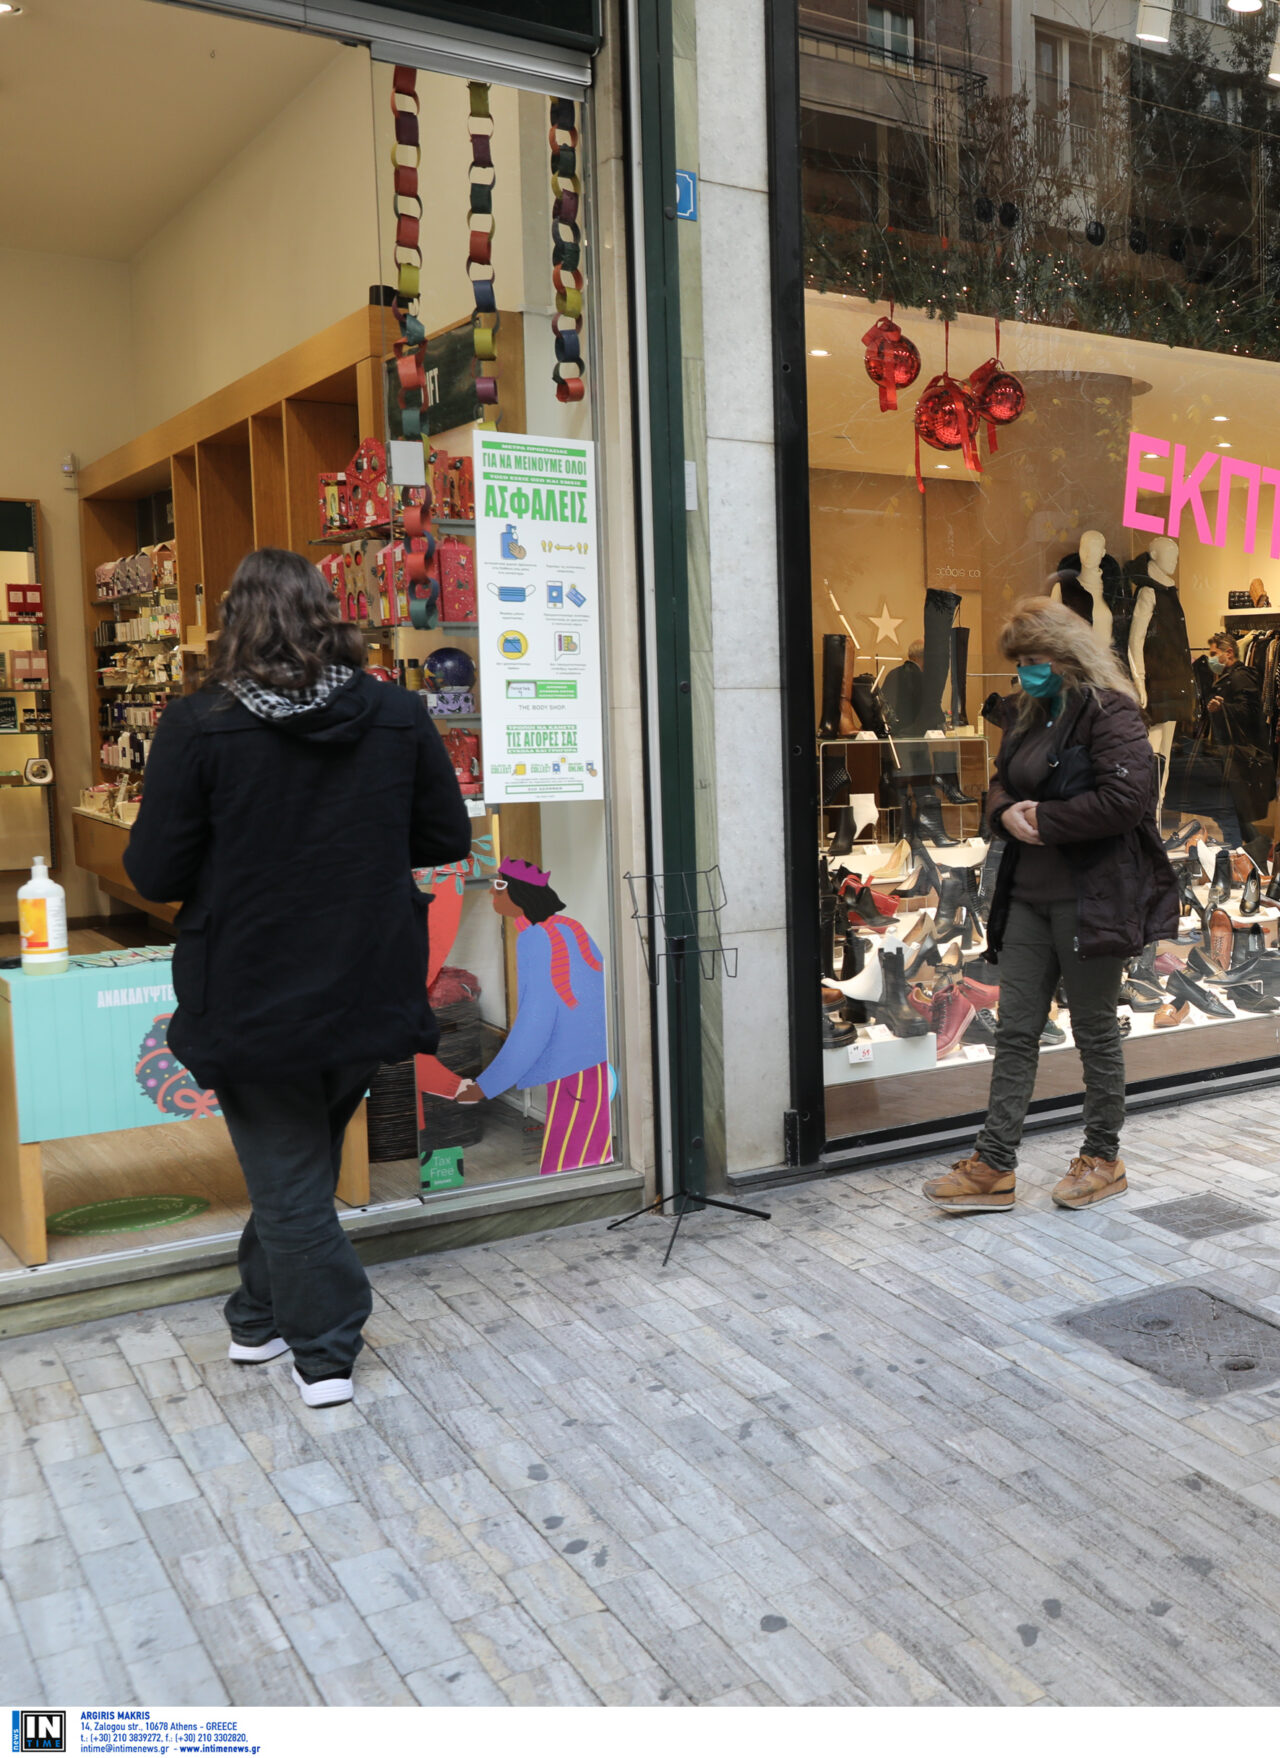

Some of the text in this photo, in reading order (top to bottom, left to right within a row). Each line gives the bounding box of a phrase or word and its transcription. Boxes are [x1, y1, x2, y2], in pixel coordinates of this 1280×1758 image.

[421, 367, 440, 407] IFT
[482, 452, 587, 476] ΓΙΑ ΝΑ ΜΕΙΝΟΥΜΕ ΟΛΟΙ
[484, 484, 588, 524] ΑΣΦΑΛΕΙΣ
[506, 731, 577, 747] ΤΙΣ ΑΓΟΡΕΣ ΣΑΣ
[434, 1156, 451, 1167] Tax
[431, 1167, 455, 1178] Free
